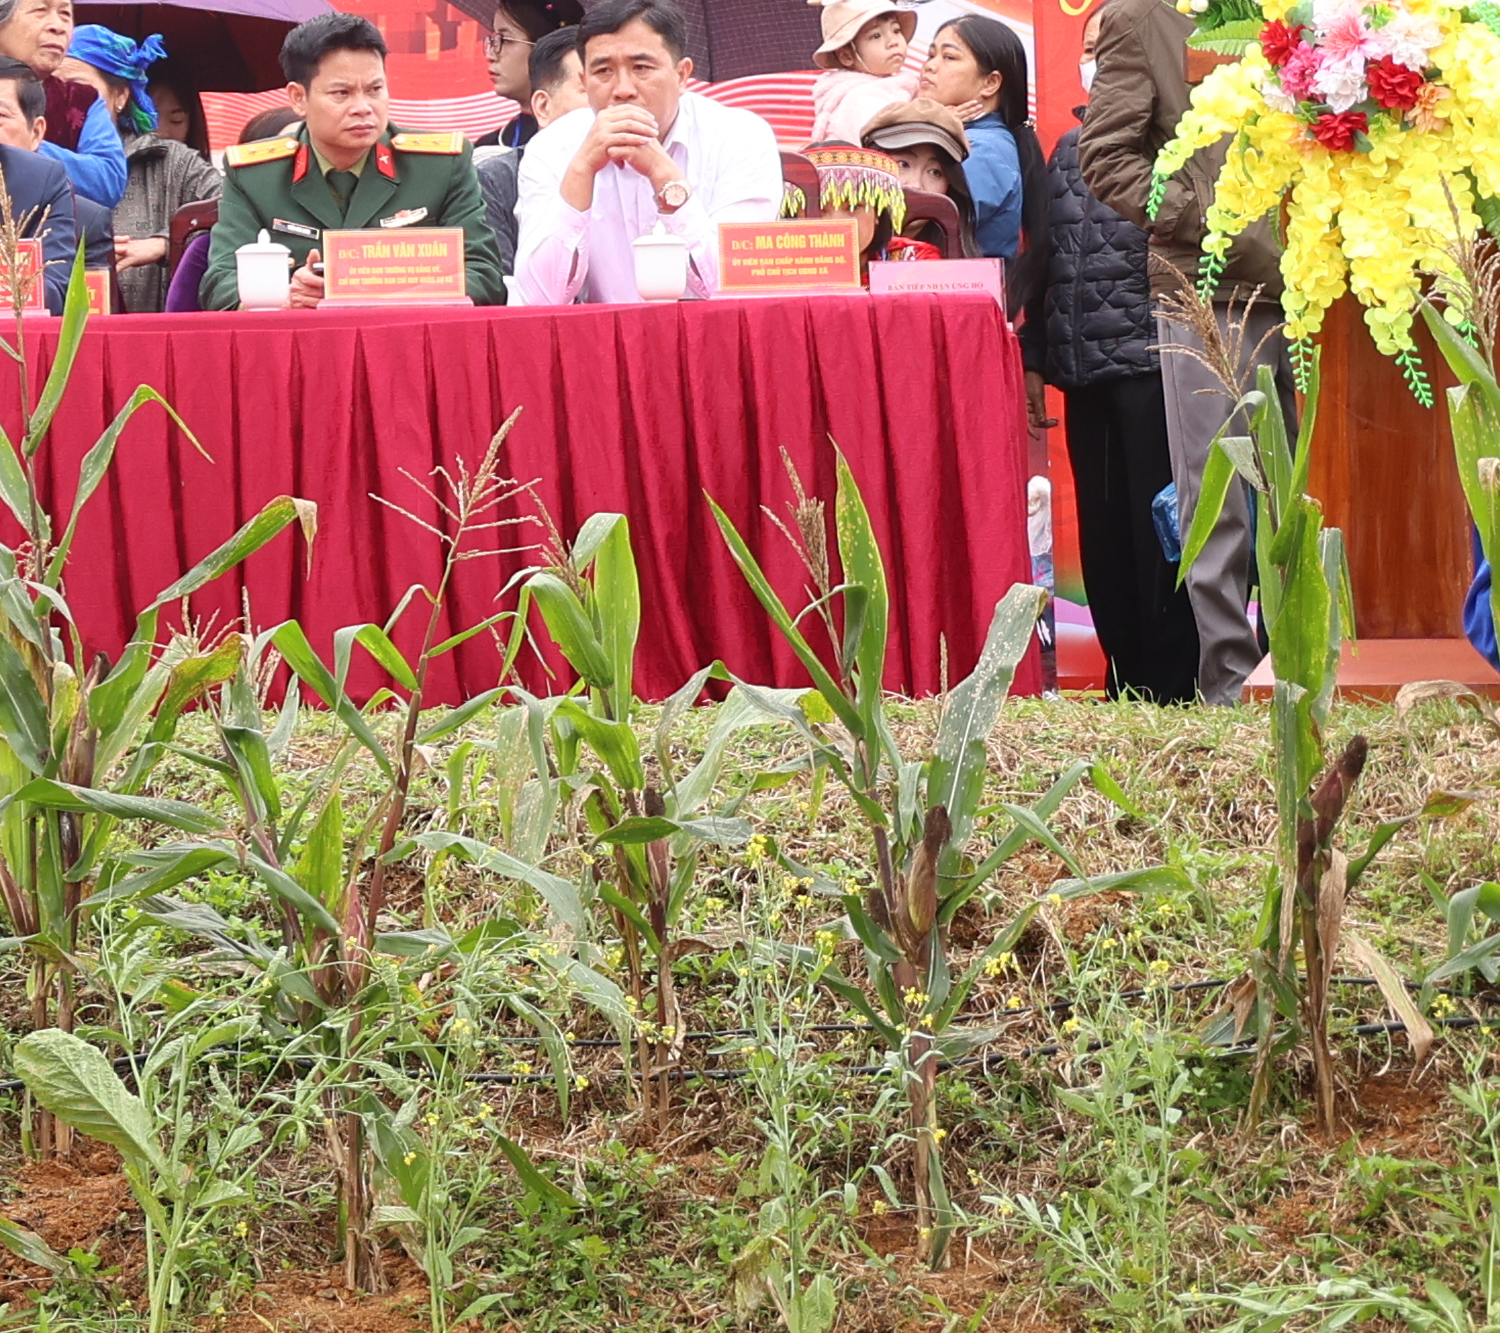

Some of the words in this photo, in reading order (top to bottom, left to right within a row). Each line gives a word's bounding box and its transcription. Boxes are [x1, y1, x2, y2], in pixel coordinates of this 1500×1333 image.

[755, 235, 774, 250] MA
[775, 232, 807, 250] CÔNG
[808, 231, 845, 248] THÀNH
